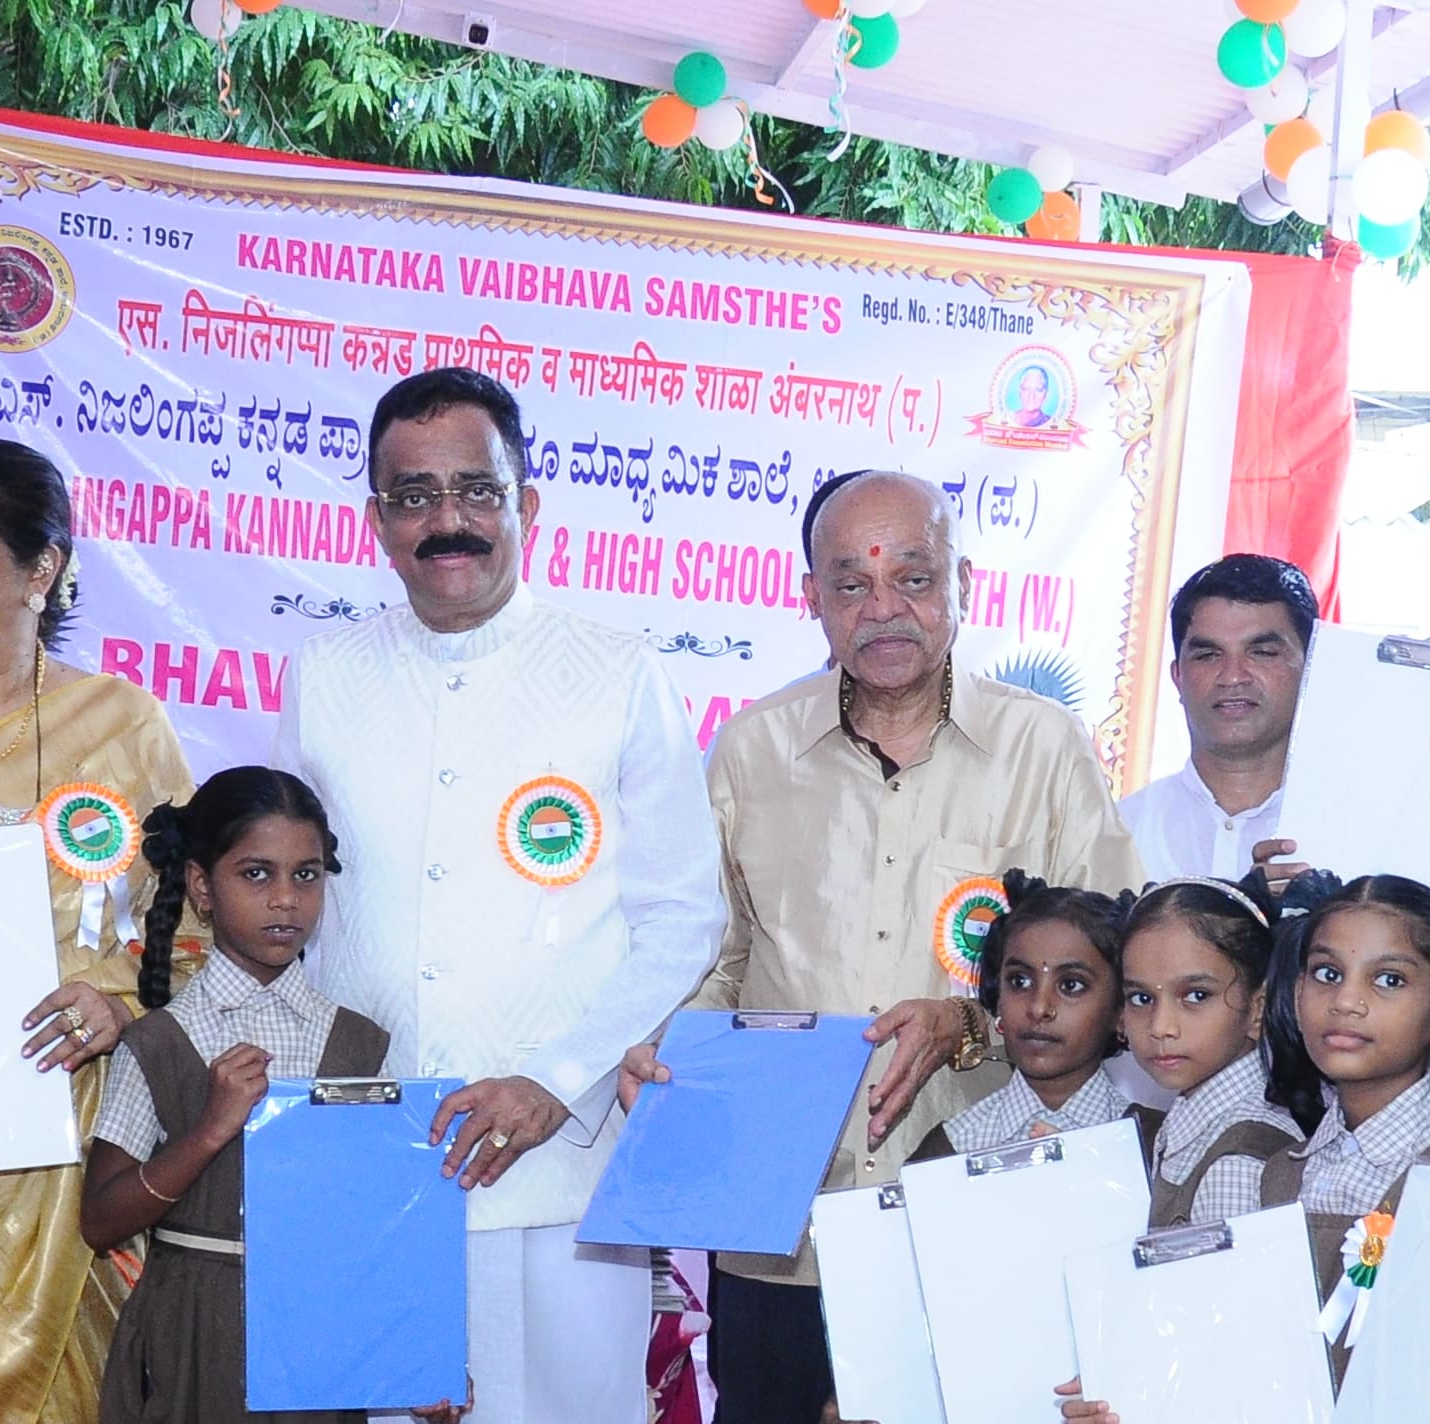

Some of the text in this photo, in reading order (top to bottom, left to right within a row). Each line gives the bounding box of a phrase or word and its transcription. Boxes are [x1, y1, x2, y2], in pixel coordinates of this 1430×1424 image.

[59, 211, 118, 241] ESTD.
[142, 225, 194, 250] 1967
[237, 233, 843, 334] KARNATAKA VAIBHAVA SAMSTHE'S
[862, 293, 903, 326] Regd.
[908, 301, 931, 325] No.
[946, 302, 1035, 336] E/348/Thane
[118, 299, 169, 356] एस.
[342, 325, 417, 377] कन्नड
[541, 347, 562, 393] व
[569, 341, 687, 406] माध्यमिक
[770, 361, 881, 428] अंबरनाथ
[887, 374, 942, 449] (प.)
[224, 492, 377, 567] KANNADA
[548, 526, 570, 587] &
[582, 530, 663, 600] HIGH
[672, 538, 807, 620] SCHOOL,
[1019, 573, 1074, 649] (W.)
